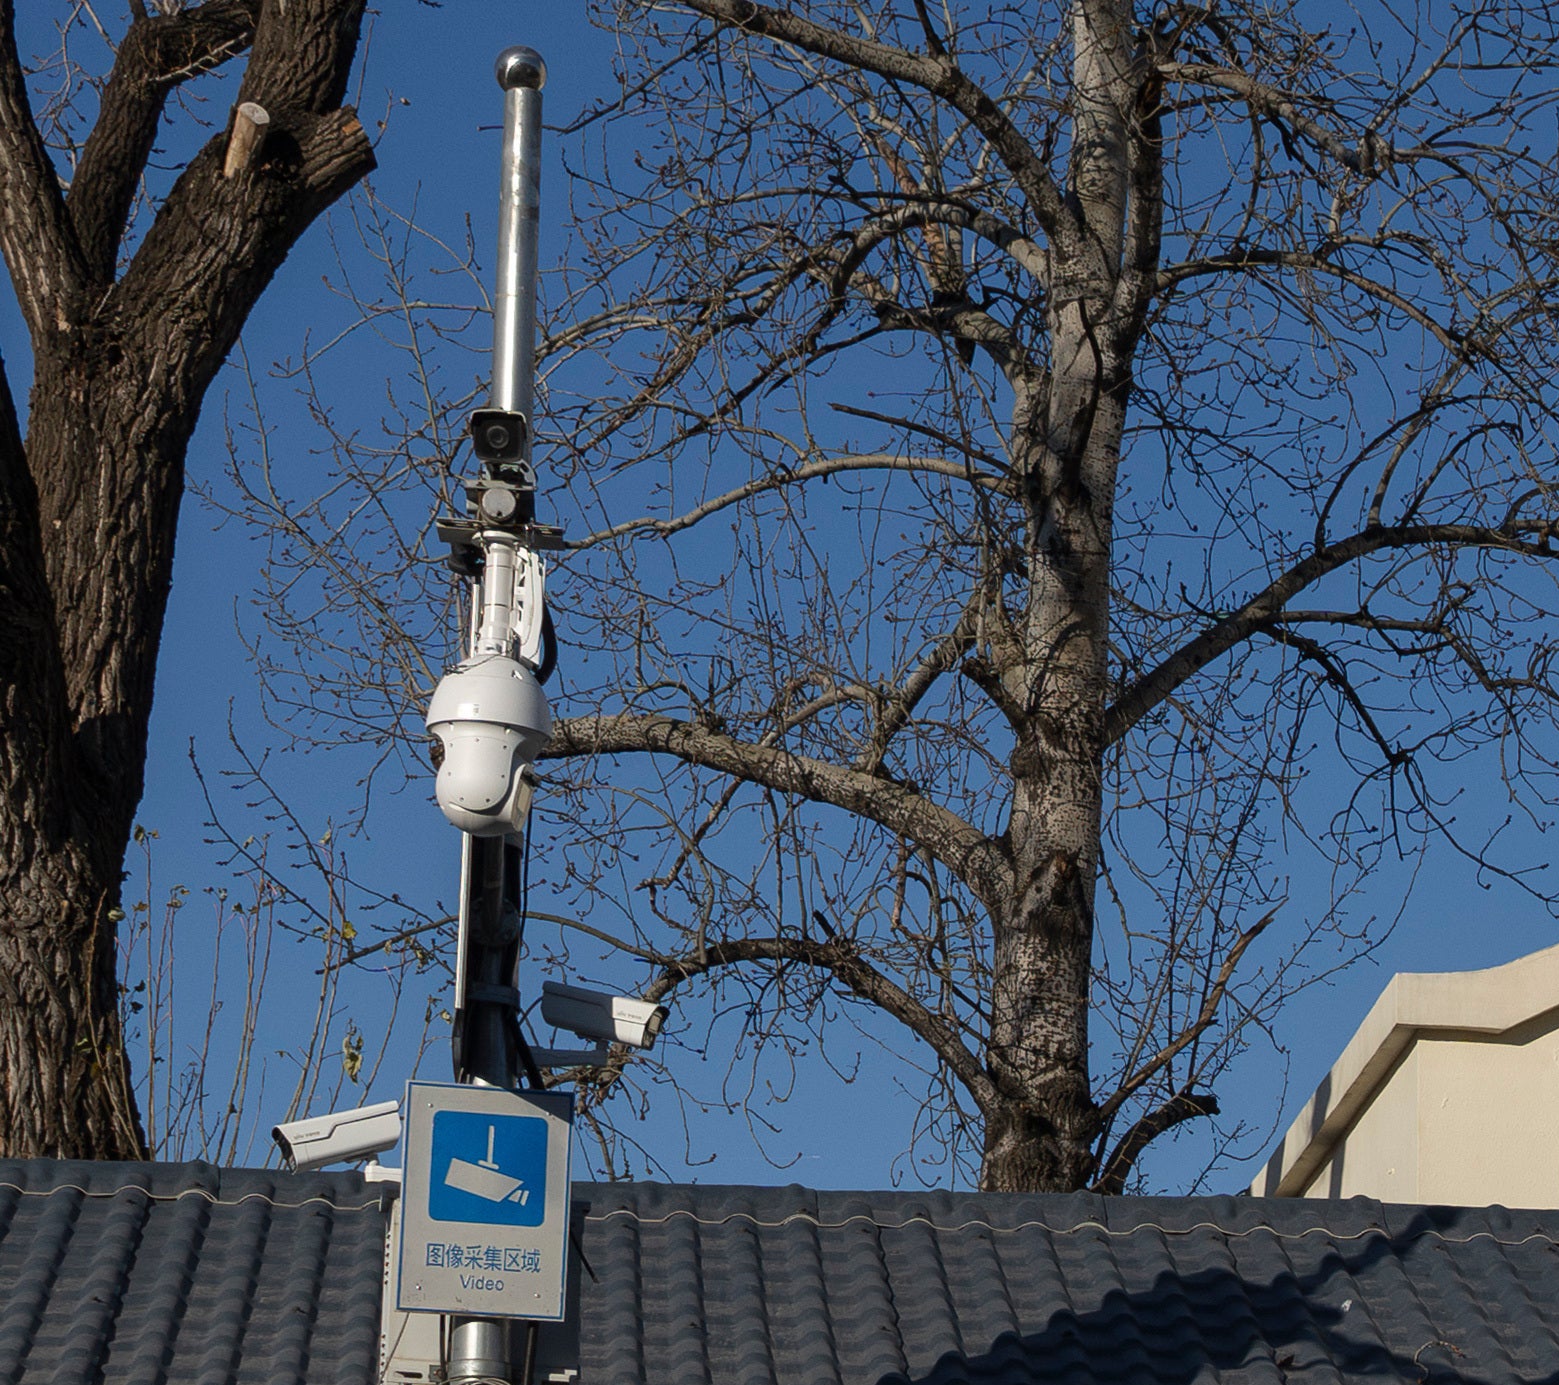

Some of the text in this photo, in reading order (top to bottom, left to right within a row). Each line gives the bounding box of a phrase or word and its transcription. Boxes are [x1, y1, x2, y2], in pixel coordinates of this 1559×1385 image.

[426, 1243, 541, 1273] 图像采集区域
[460, 1274, 504, 1291] Video
